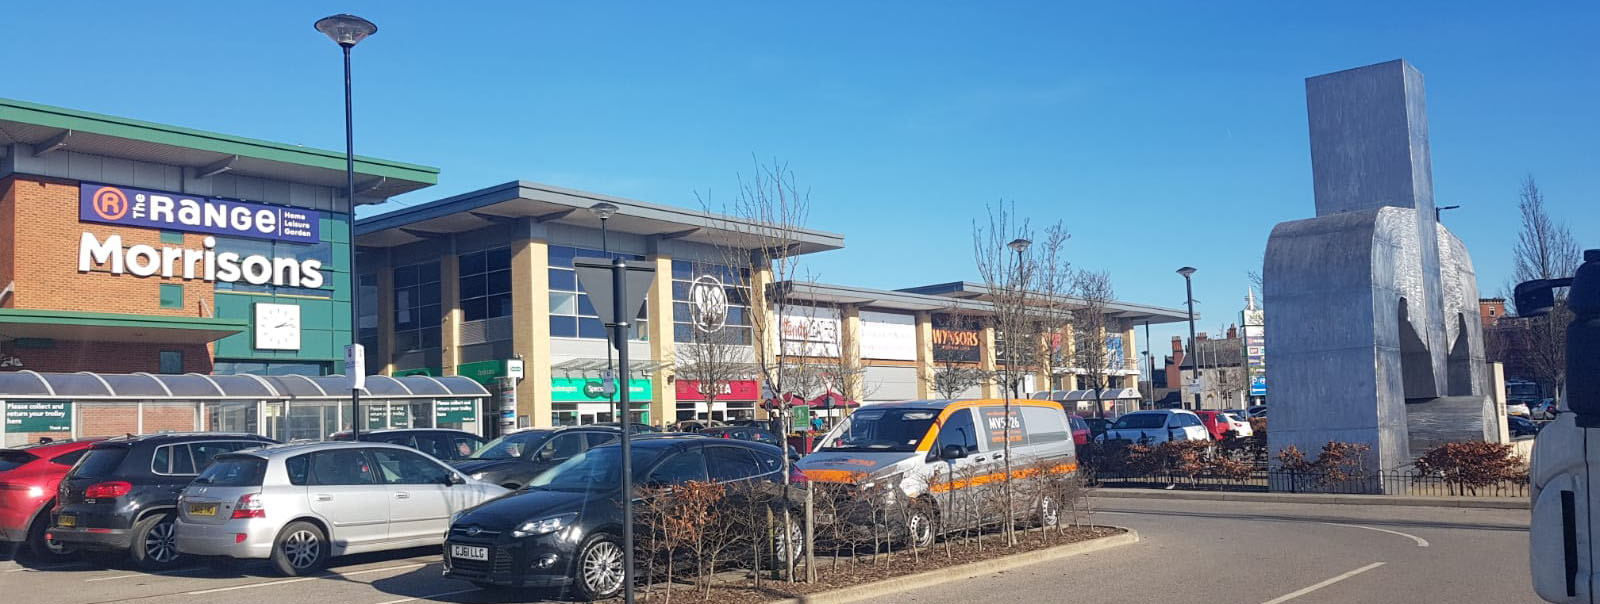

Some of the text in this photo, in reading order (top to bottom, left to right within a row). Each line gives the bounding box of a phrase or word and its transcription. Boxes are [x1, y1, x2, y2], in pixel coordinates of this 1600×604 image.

[132, 194, 146, 219] The
[284, 212, 306, 221] Home
[284, 220, 311, 229] Leisure
[284, 228, 312, 238] Garden
[78, 232, 324, 289] Morrisons
[45, 410, 66, 418] trolley
[989, 417, 1020, 430] MV526
